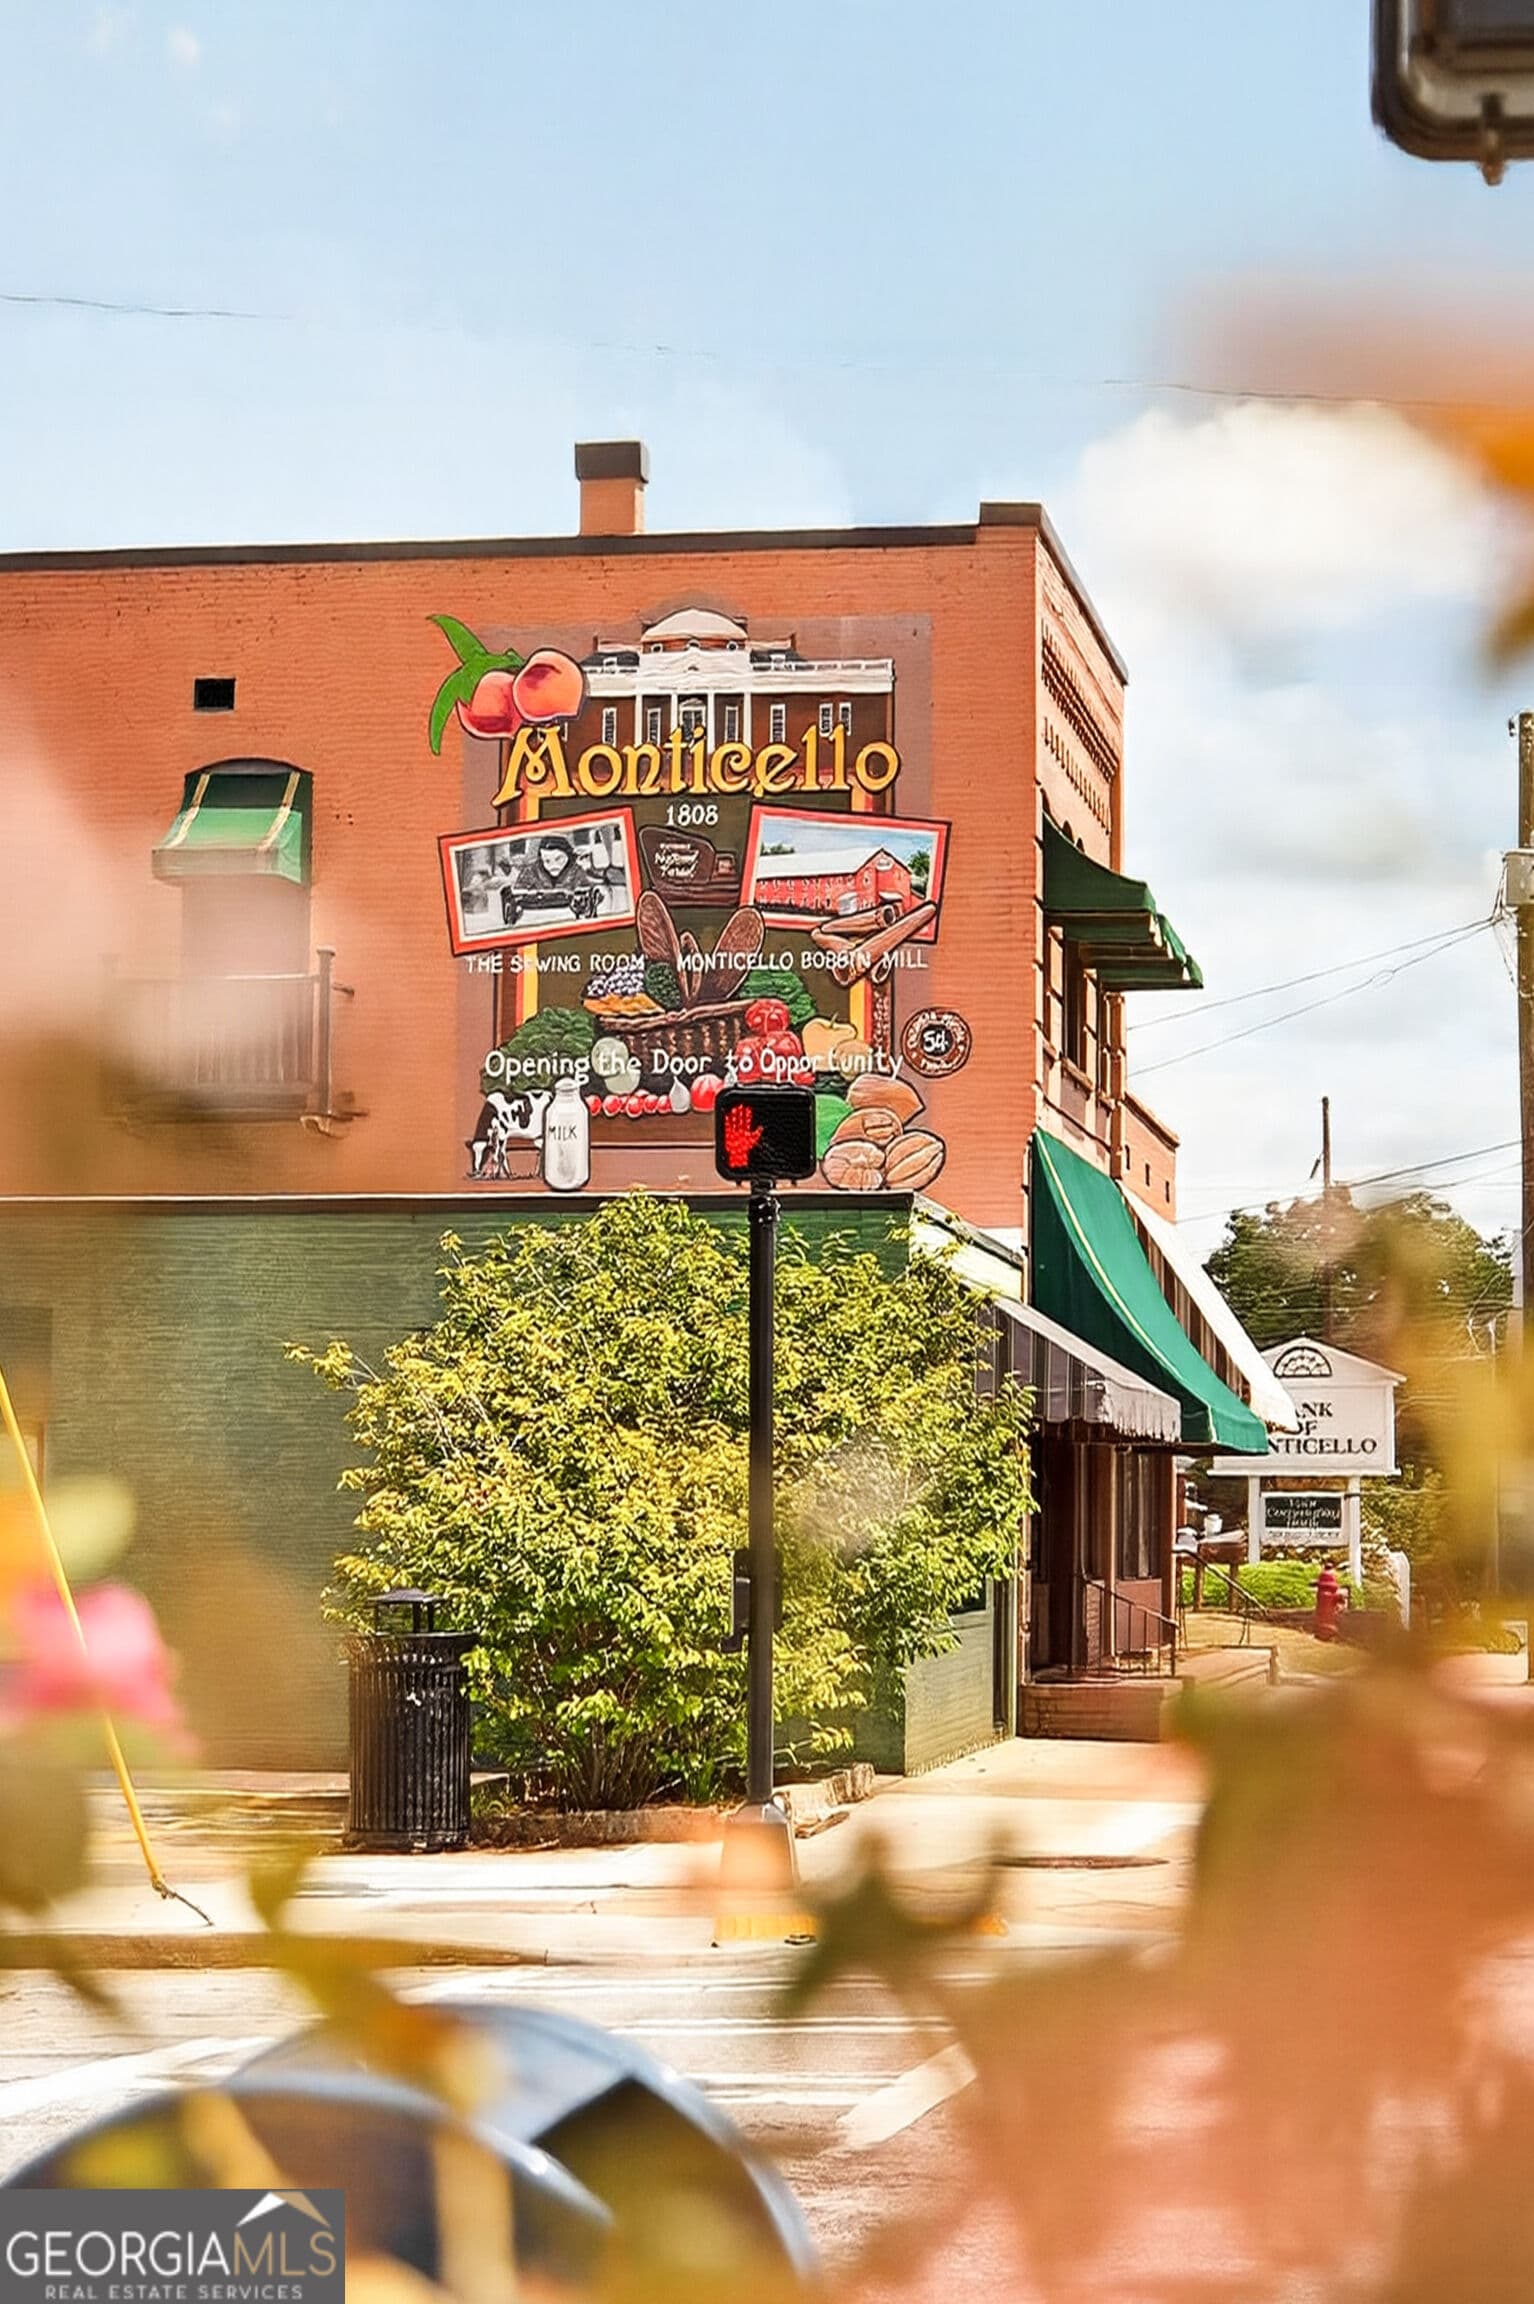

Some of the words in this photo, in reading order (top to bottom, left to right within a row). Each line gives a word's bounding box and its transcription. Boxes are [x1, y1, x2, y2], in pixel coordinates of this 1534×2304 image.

[492, 724, 900, 806] Monticello
[664, 803, 720, 827] 1808
[465, 954, 504, 973] THE
[589, 954, 646, 973] ROOM
[676, 951, 794, 971] MONTICELLO
[882, 950, 928, 969] MILL
[484, 1051, 591, 1086] Opening
[599, 1051, 642, 1077] the
[651, 1048, 713, 1075] Door
[724, 1048, 754, 1072] to
[760, 1046, 904, 1082] Opportunity
[548, 1124, 578, 1141] MILK
[1294, 1402, 1333, 1418] NK
[1267, 1438, 1377, 1455] NTICELLO
